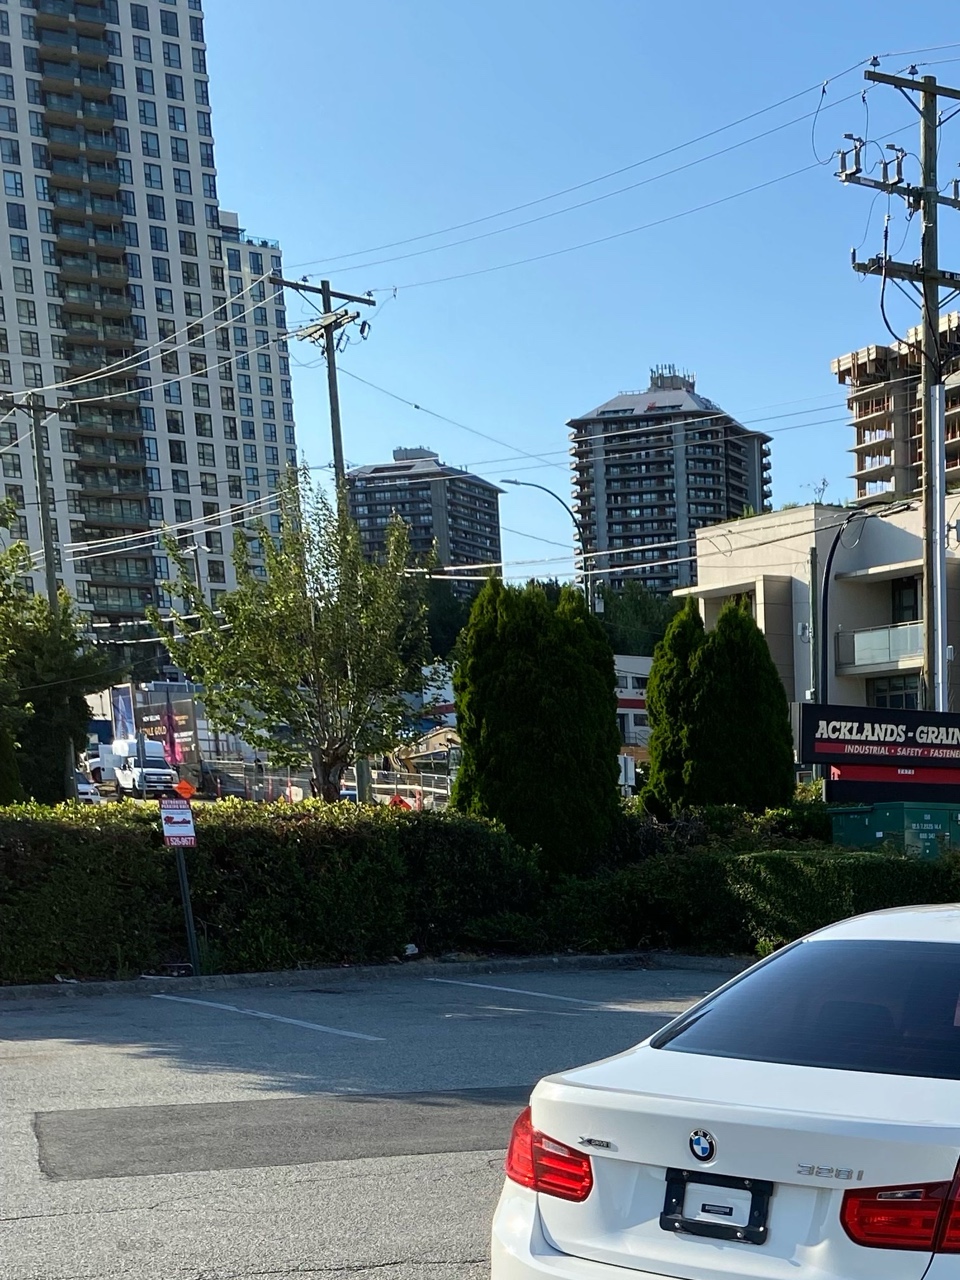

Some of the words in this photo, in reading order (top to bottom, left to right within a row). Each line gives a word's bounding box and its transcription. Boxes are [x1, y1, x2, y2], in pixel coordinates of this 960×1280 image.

[815, 720, 906, 743] ACKLANDS
[844, 744, 889, 755] INDUSTRIAL
[896, 747, 923, 757] SAFETY
